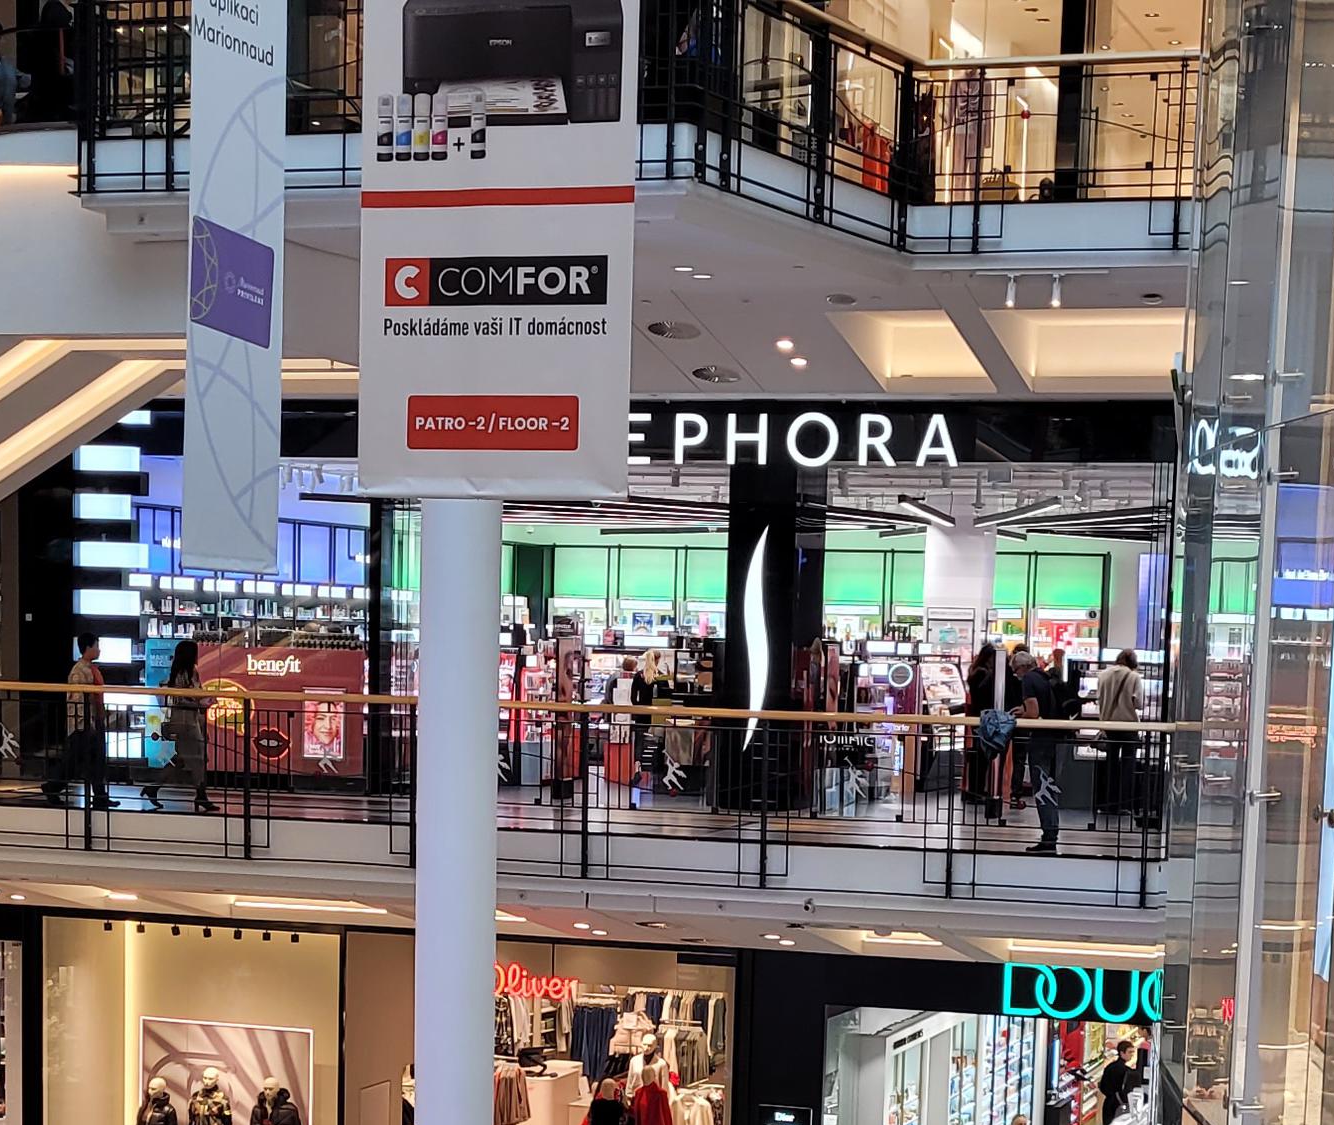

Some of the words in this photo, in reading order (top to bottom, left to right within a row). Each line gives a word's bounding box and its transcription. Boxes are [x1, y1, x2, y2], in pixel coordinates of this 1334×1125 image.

[194, 14, 274, 67] Marionnaud
[384, 317, 469, 336] Poskládáme
[474, 316, 503, 336] vaši
[509, 317, 522, 336] IT
[528, 316, 607, 336] domácnost
[416, 417, 465, 431] PATRO
[499, 417, 548, 431] FLOOR
[627, 411, 959, 467] EPHORA
[246, 655, 301, 676] benefit
